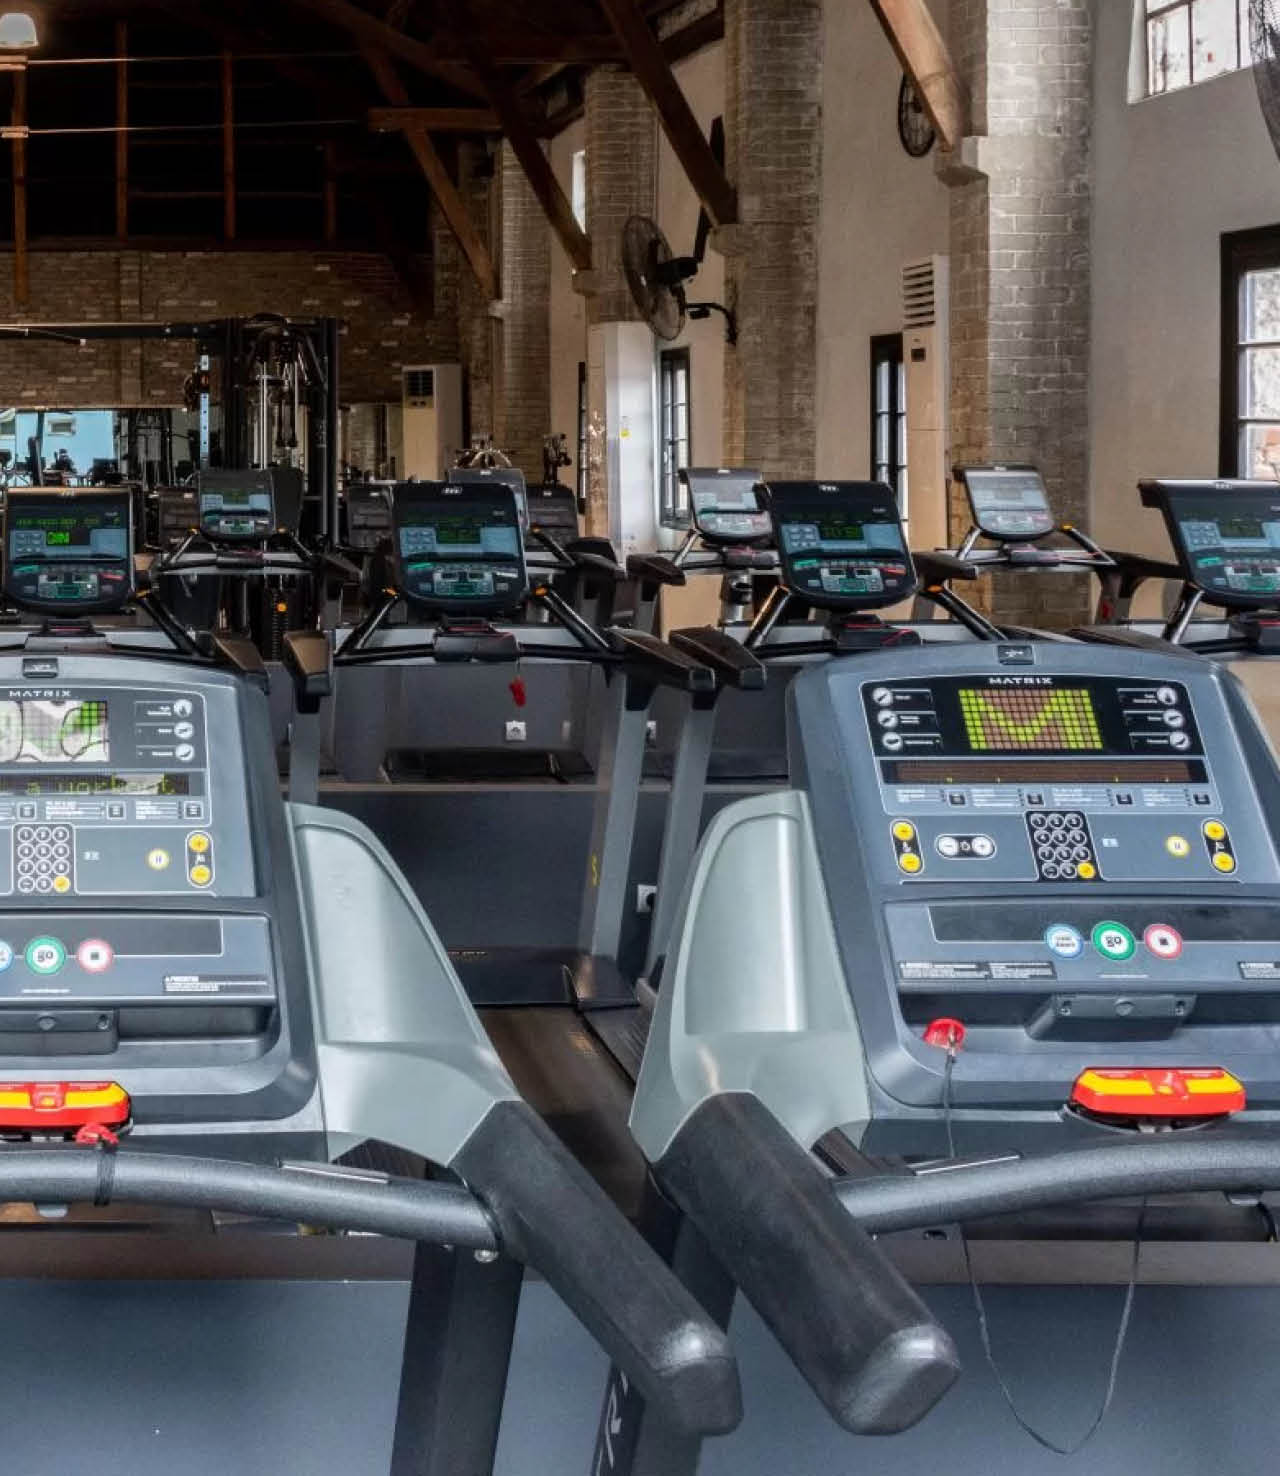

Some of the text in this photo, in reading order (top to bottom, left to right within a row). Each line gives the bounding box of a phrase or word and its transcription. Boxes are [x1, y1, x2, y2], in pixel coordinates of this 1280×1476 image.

[988, 677, 1053, 685] MATRIX
[8, 690, 72, 698] MATRIX
[1106, 935, 1123, 948] go
[37, 951, 54, 963] go
